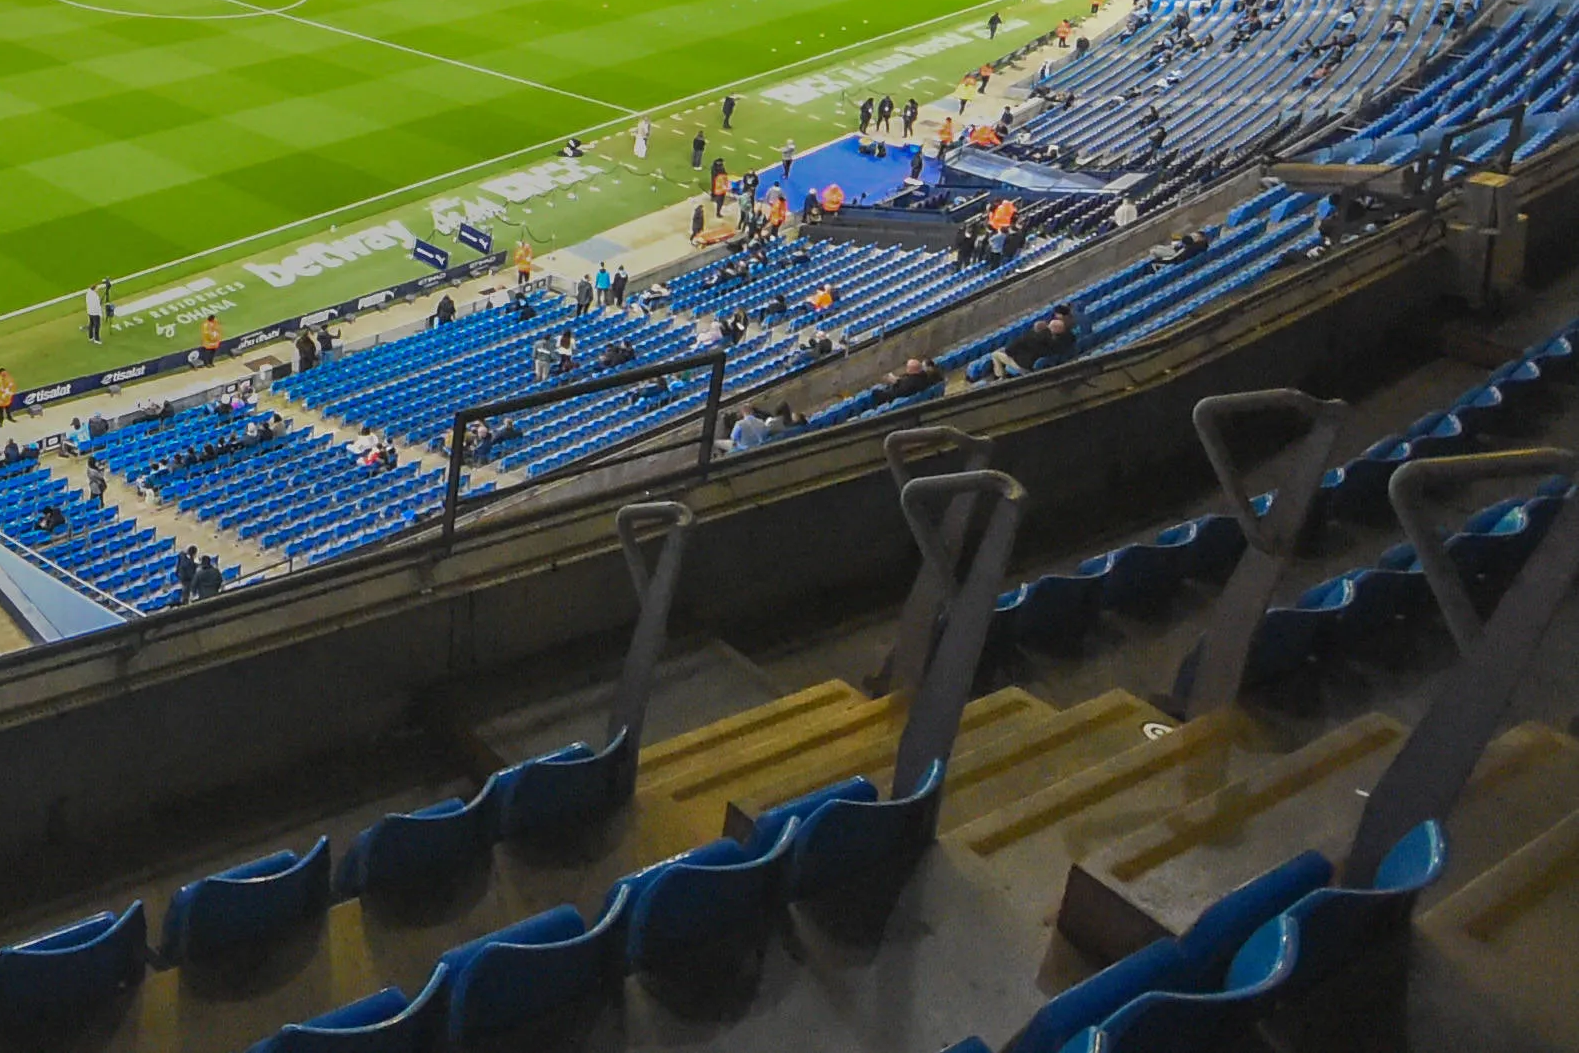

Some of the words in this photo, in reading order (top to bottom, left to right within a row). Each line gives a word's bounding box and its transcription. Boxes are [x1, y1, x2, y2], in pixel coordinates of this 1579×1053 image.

[242, 219, 417, 288] betway
[176, 299, 238, 325] OHANA
[101, 365, 147, 385] etisalat
[23, 384, 72, 405] etisalat
